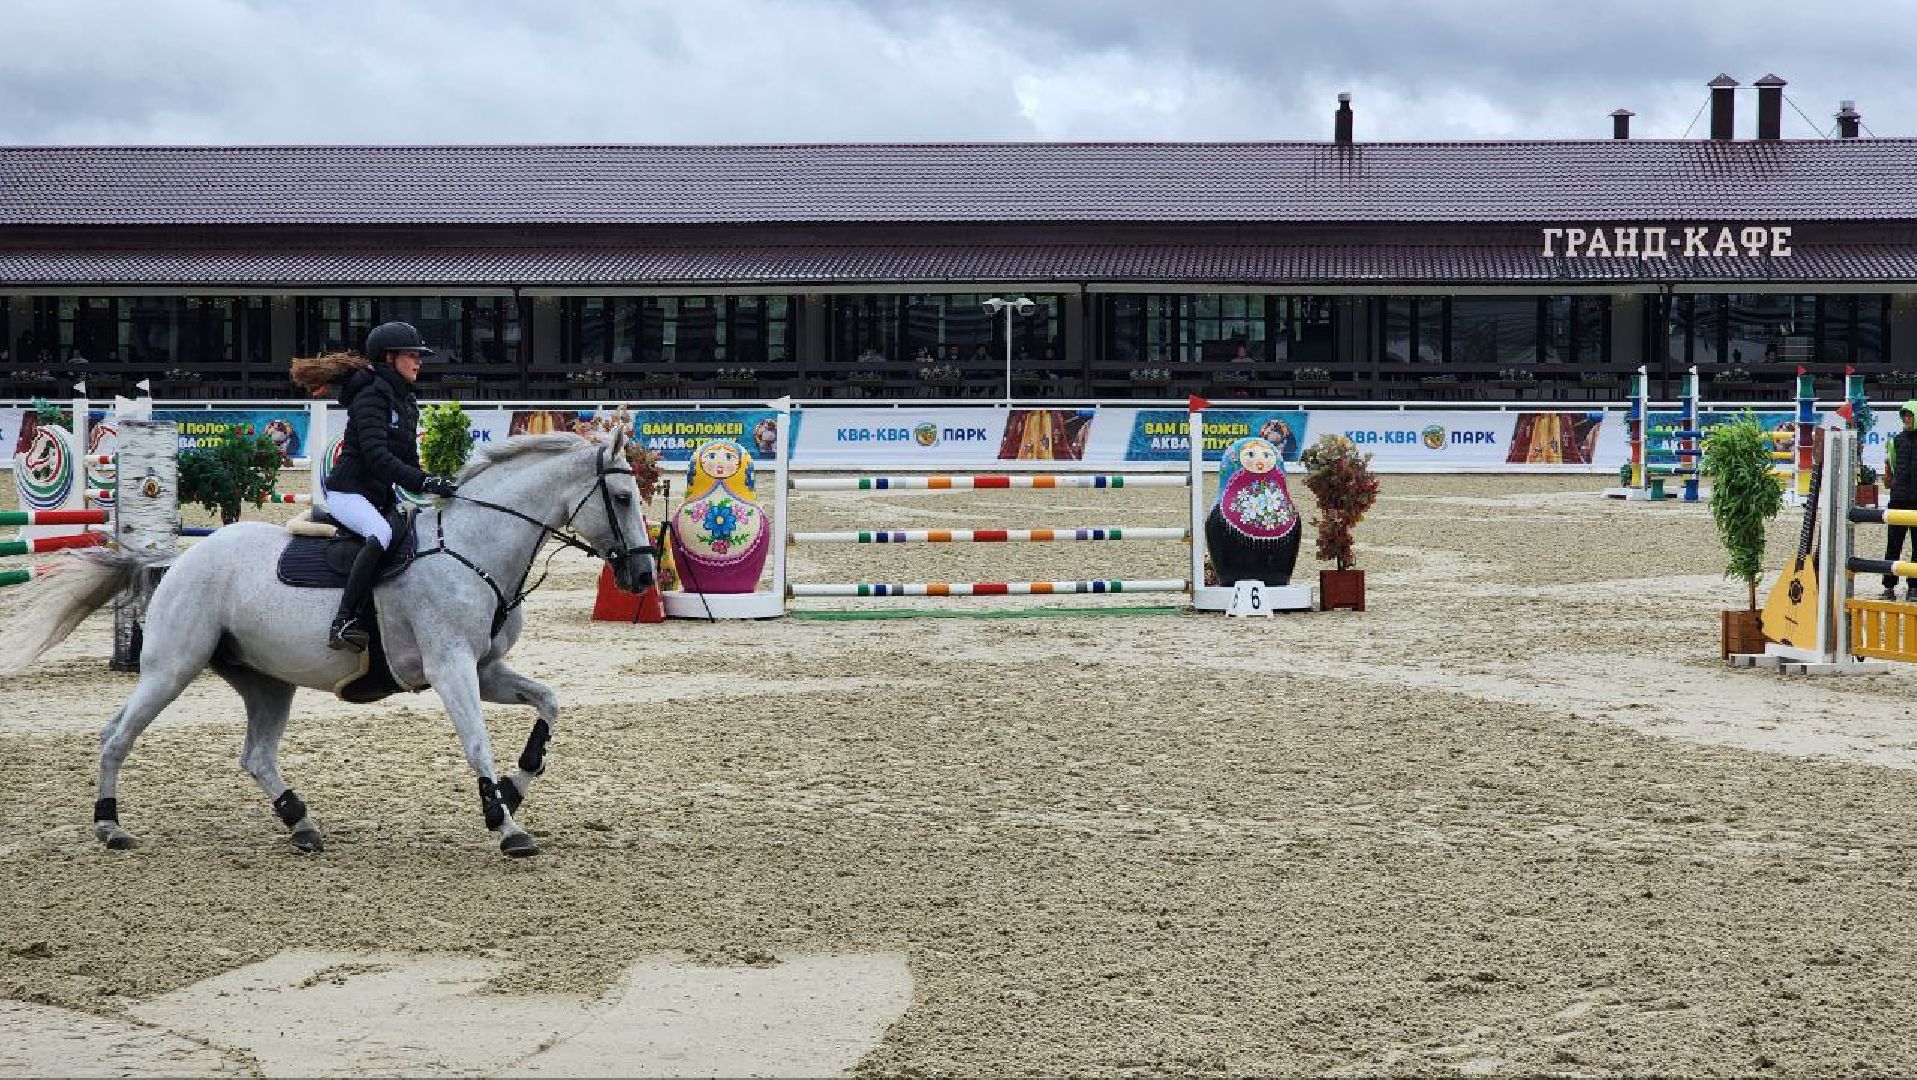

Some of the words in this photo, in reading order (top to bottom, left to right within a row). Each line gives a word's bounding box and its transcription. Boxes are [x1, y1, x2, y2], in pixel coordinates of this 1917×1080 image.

[1542, 226, 1792, 260] ГРАНД-КАФЕ
[642, 422, 673, 434] ВАМ
[943, 428, 987, 442] ПАРК
[1144, 422, 1176, 435] ВАМ
[1179, 422, 1249, 435] ПЛОЖЕН
[1451, 430, 1495, 444] ПАРК
[1251, 586, 1261, 610] 6
